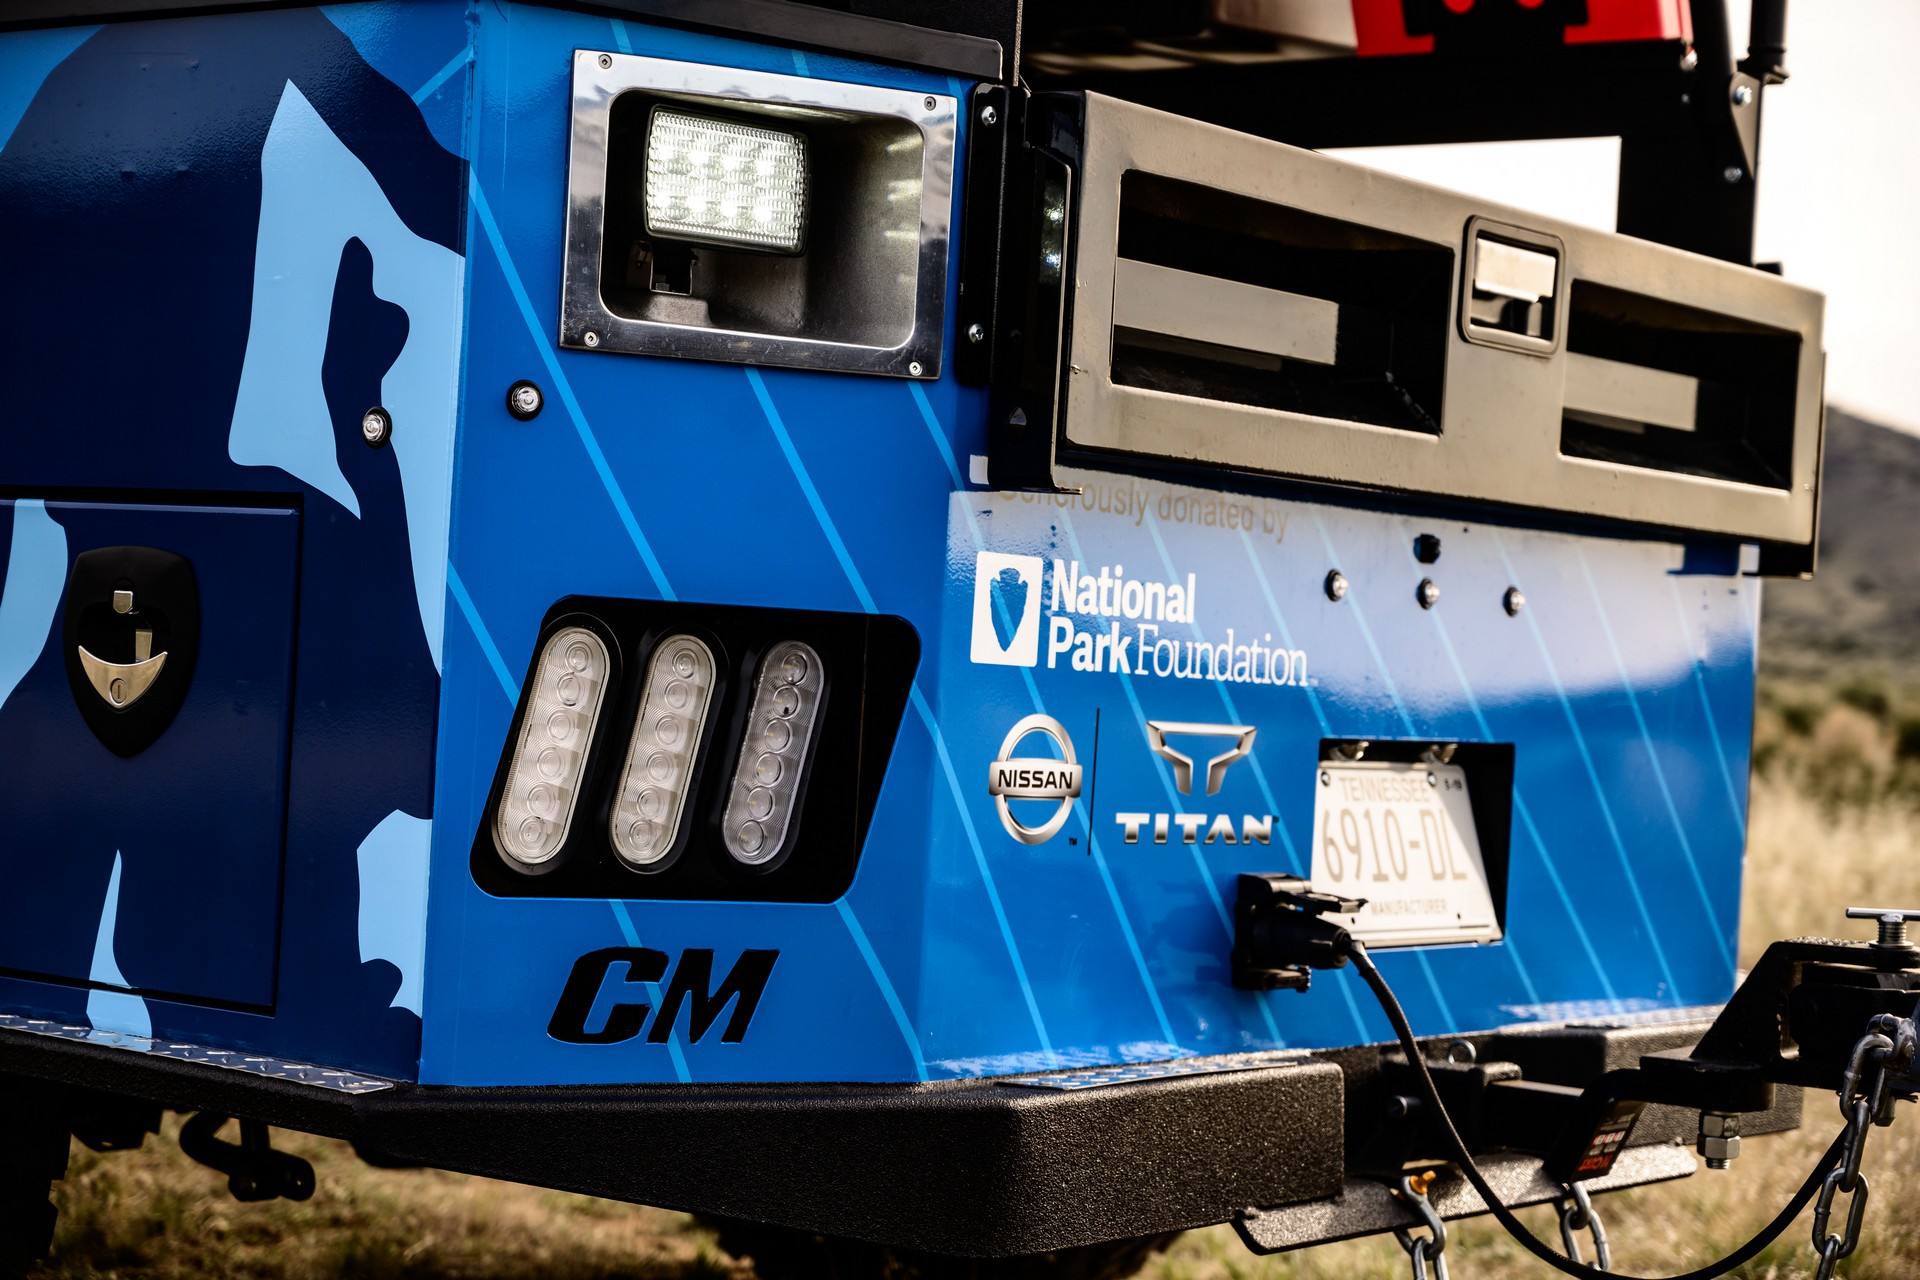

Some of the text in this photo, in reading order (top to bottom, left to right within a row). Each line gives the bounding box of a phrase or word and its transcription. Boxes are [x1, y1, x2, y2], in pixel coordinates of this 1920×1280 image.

[1158, 486, 1254, 532] donated
[1263, 503, 1289, 544] by
[1051, 559, 1196, 624] National
[1047, 616, 1309, 687] Park Foundation
[998, 769, 1073, 789] NISSAN
[1338, 776, 1430, 803] TENNESSEE
[1115, 812, 1273, 845] TITAN
[1323, 807, 1468, 883] 6910-DL
[1369, 898, 1448, 917] MANUFACTURER
[546, 946, 781, 1046] CM
